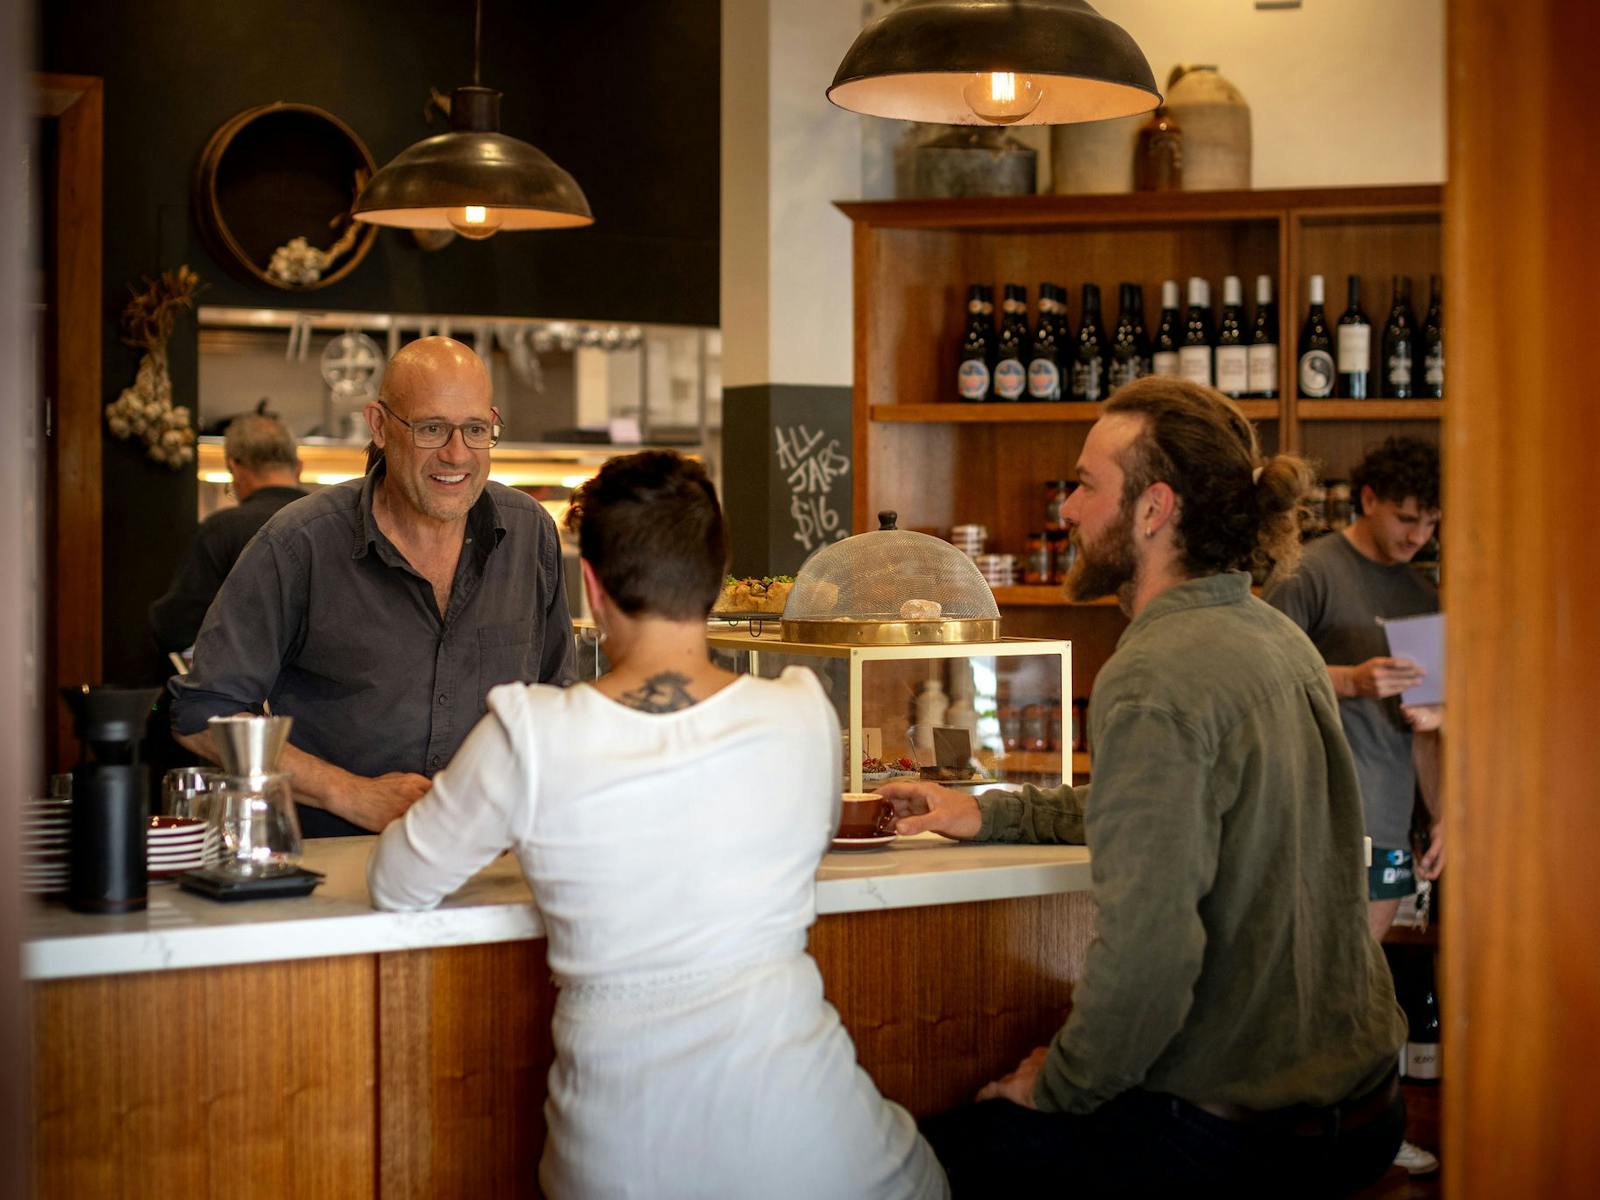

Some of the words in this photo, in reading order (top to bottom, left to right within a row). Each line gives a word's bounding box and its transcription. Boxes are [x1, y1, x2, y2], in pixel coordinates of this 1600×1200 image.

[775, 425, 824, 470] ALL
[787, 440, 851, 494] JARS
[791, 495, 839, 551] $16
